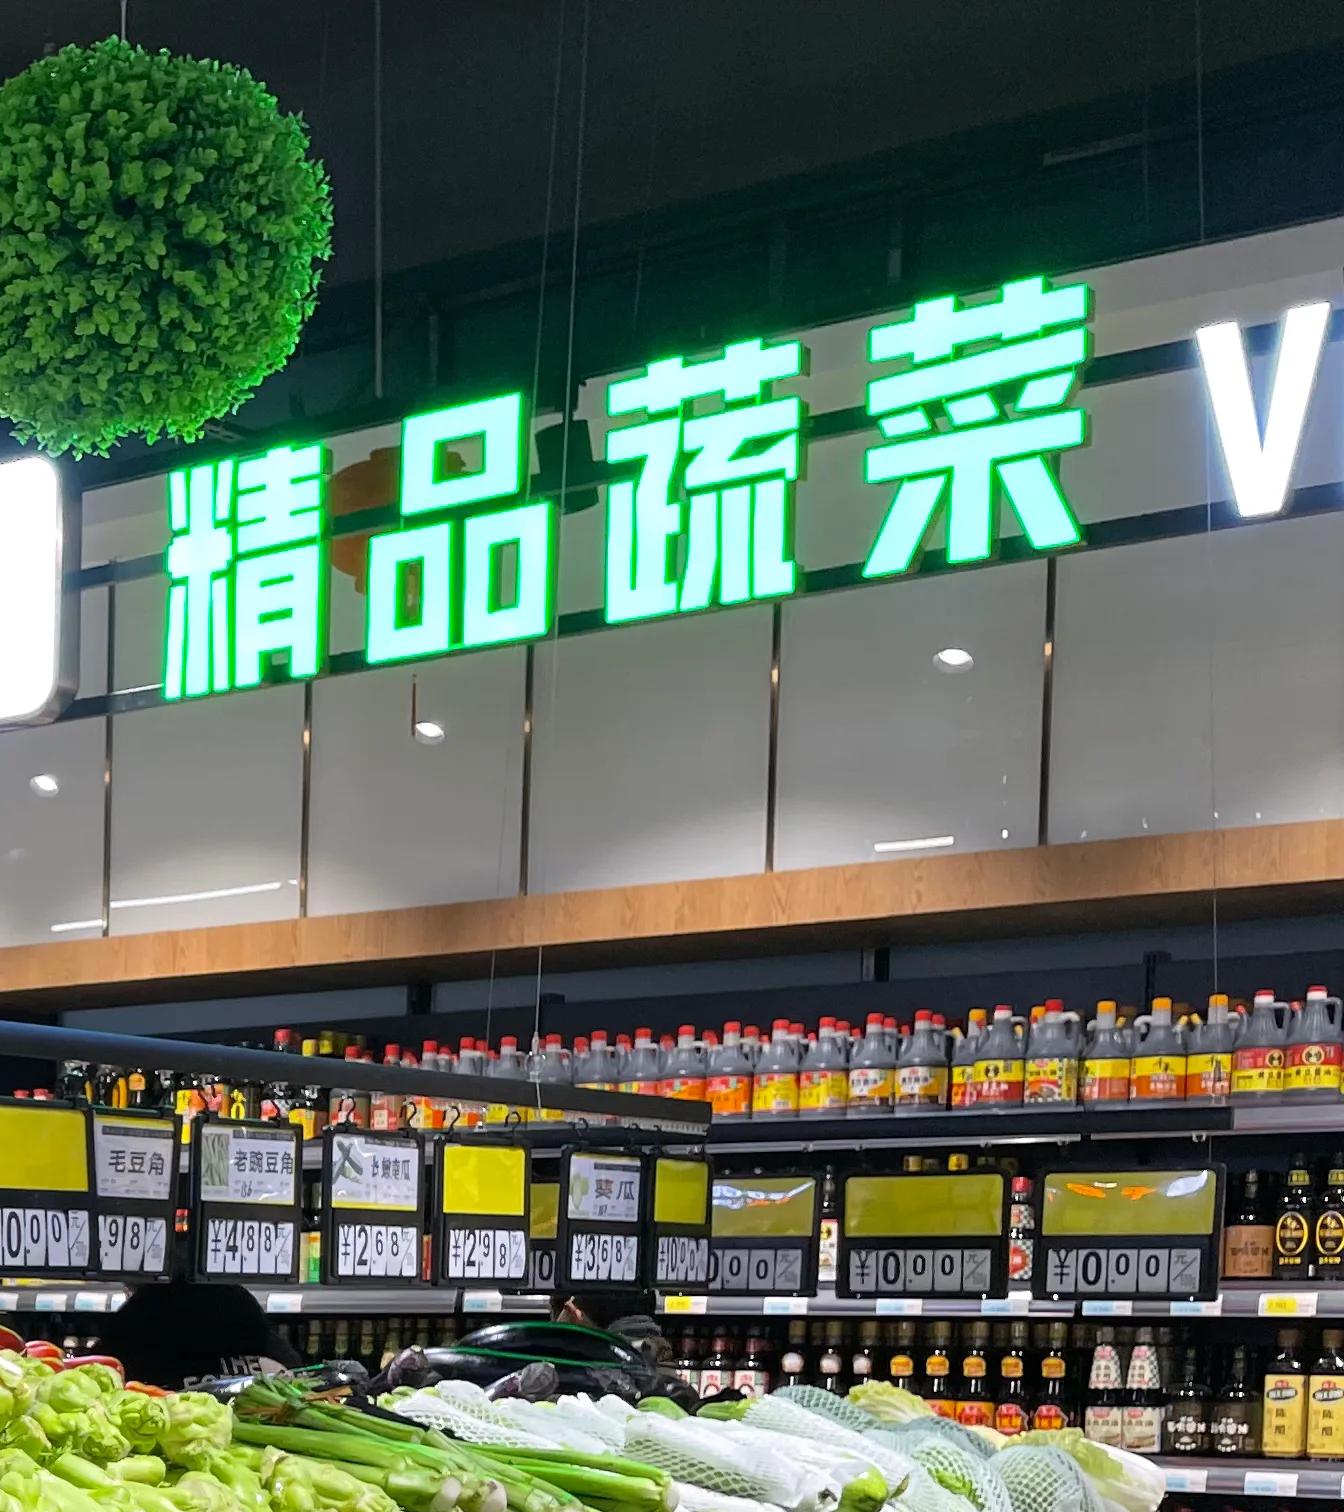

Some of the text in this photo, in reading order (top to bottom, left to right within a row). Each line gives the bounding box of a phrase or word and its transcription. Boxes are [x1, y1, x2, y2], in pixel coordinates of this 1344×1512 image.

[1196, 300, 1331, 517] V
[162, 274, 1090, 700] 精品蔬菜
[108, 1149, 165, 1176] 毛豆角
[234, 1150, 295, 1175] 老豌豆角
[210, 1218, 272, 1263] ¥4.88
[852, 1248, 955, 1285] ¥0.00
[1052, 1248, 1160, 1285] ¥0.00
